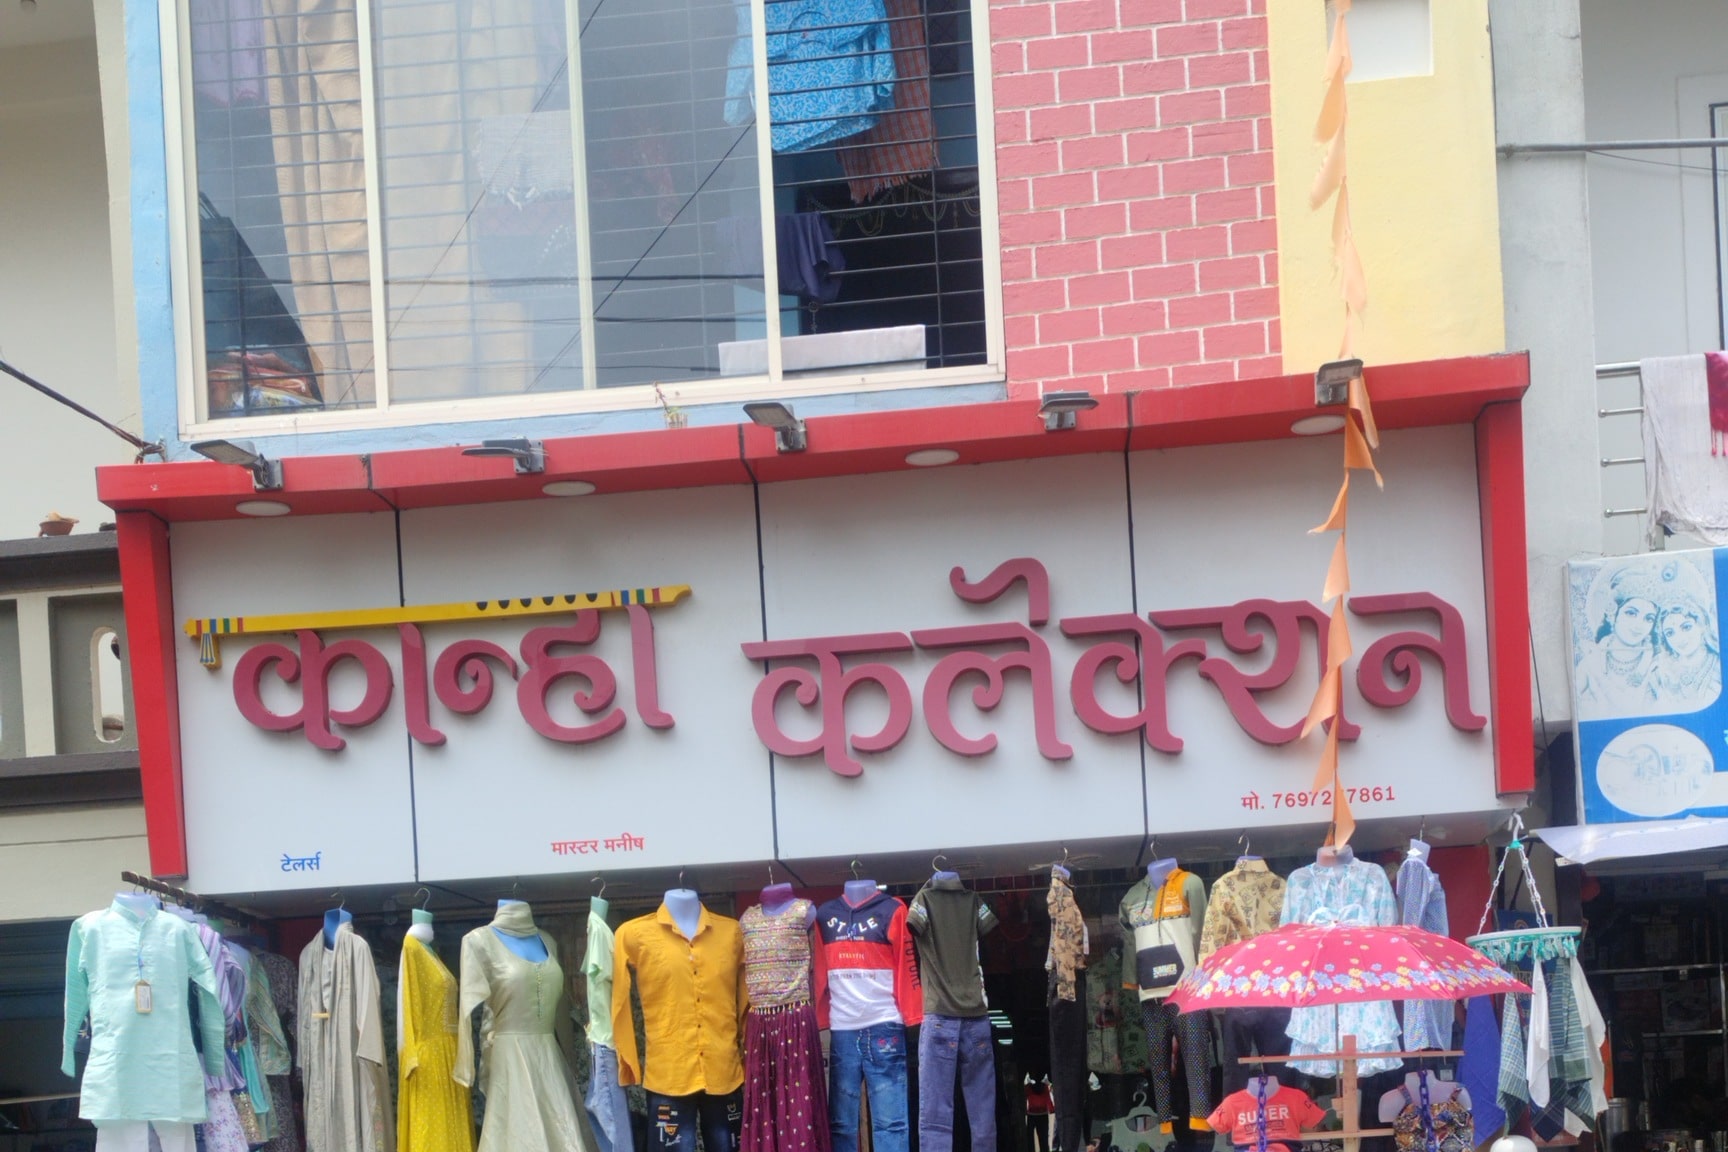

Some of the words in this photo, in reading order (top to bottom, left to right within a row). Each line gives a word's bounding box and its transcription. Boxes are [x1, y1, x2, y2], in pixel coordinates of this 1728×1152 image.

[231, 602, 676, 750] कान्हा
[741, 557, 1487, 777] कलेक्शन
[1241, 791, 1265, 810] मो.
[1272, 786, 1395, 808] 769727861
[550, 840, 599, 856] मास्टर
[603, 832, 645, 852] मनीष
[280, 850, 322, 872] टेलर्स
[1238, 1106, 1290, 1126] SUER
